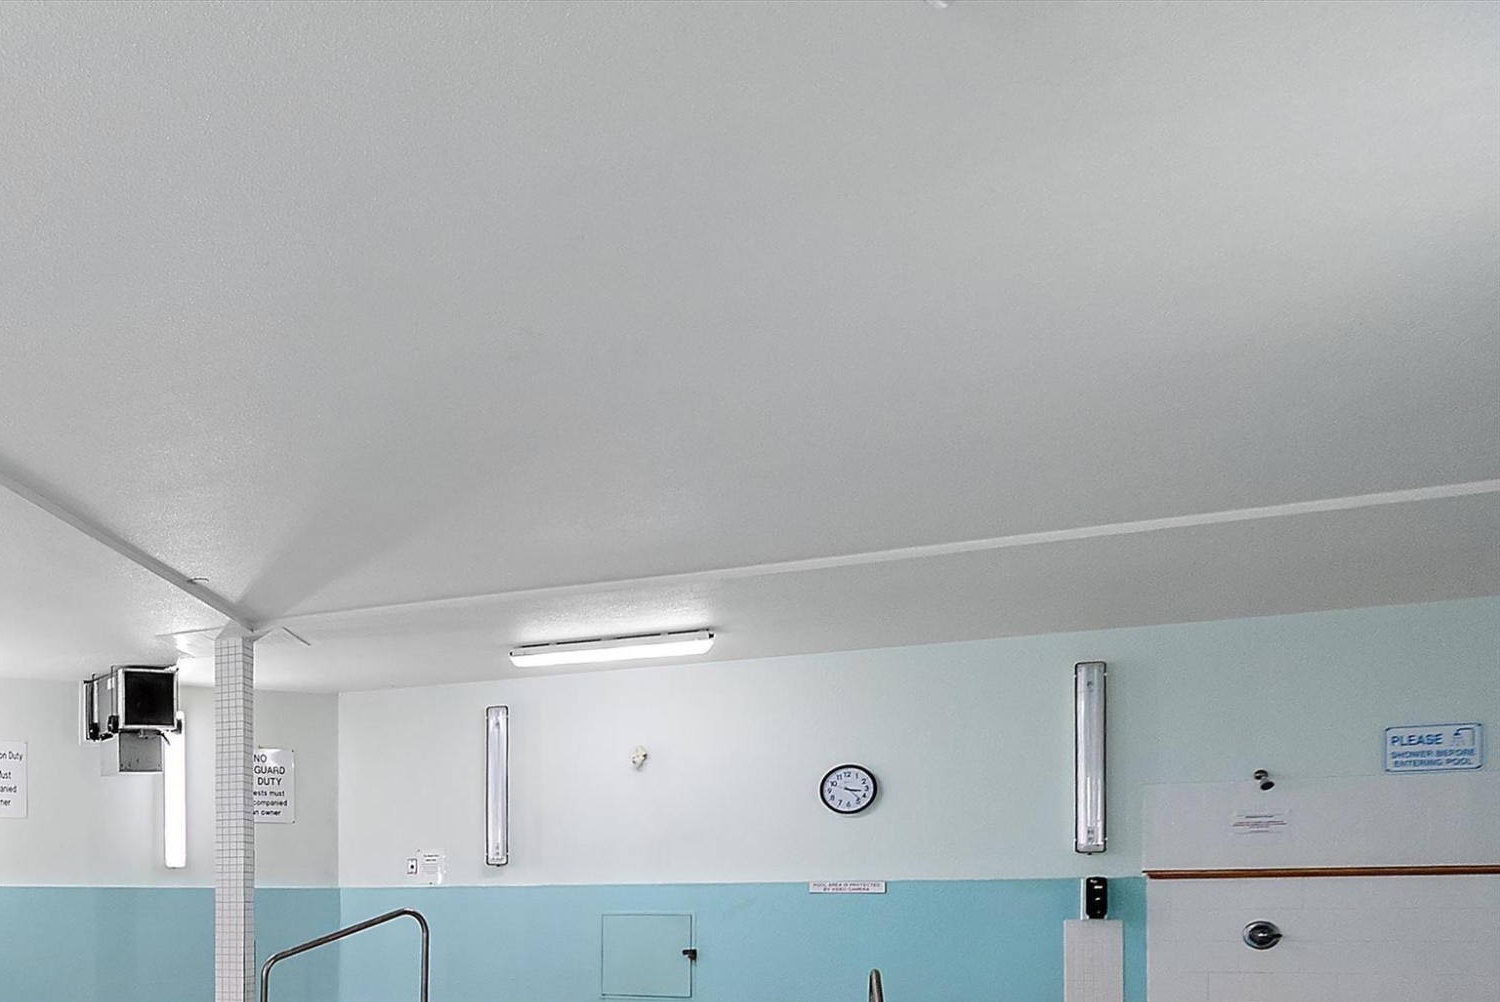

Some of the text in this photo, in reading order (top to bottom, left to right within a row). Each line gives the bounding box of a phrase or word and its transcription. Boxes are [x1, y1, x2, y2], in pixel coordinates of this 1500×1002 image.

[1391, 733, 1443, 746] PLEASE
[0, 752, 7, 760] on
[8, 751, 24, 762] Duty
[253, 754, 268, 763] NO
[1391, 748, 1475, 759] SHOWER BEFORE
[1394, 757, 1473, 768] ENTERING POOL
[254, 765, 286, 775] GUARD
[257, 776, 282, 786] DUTY
